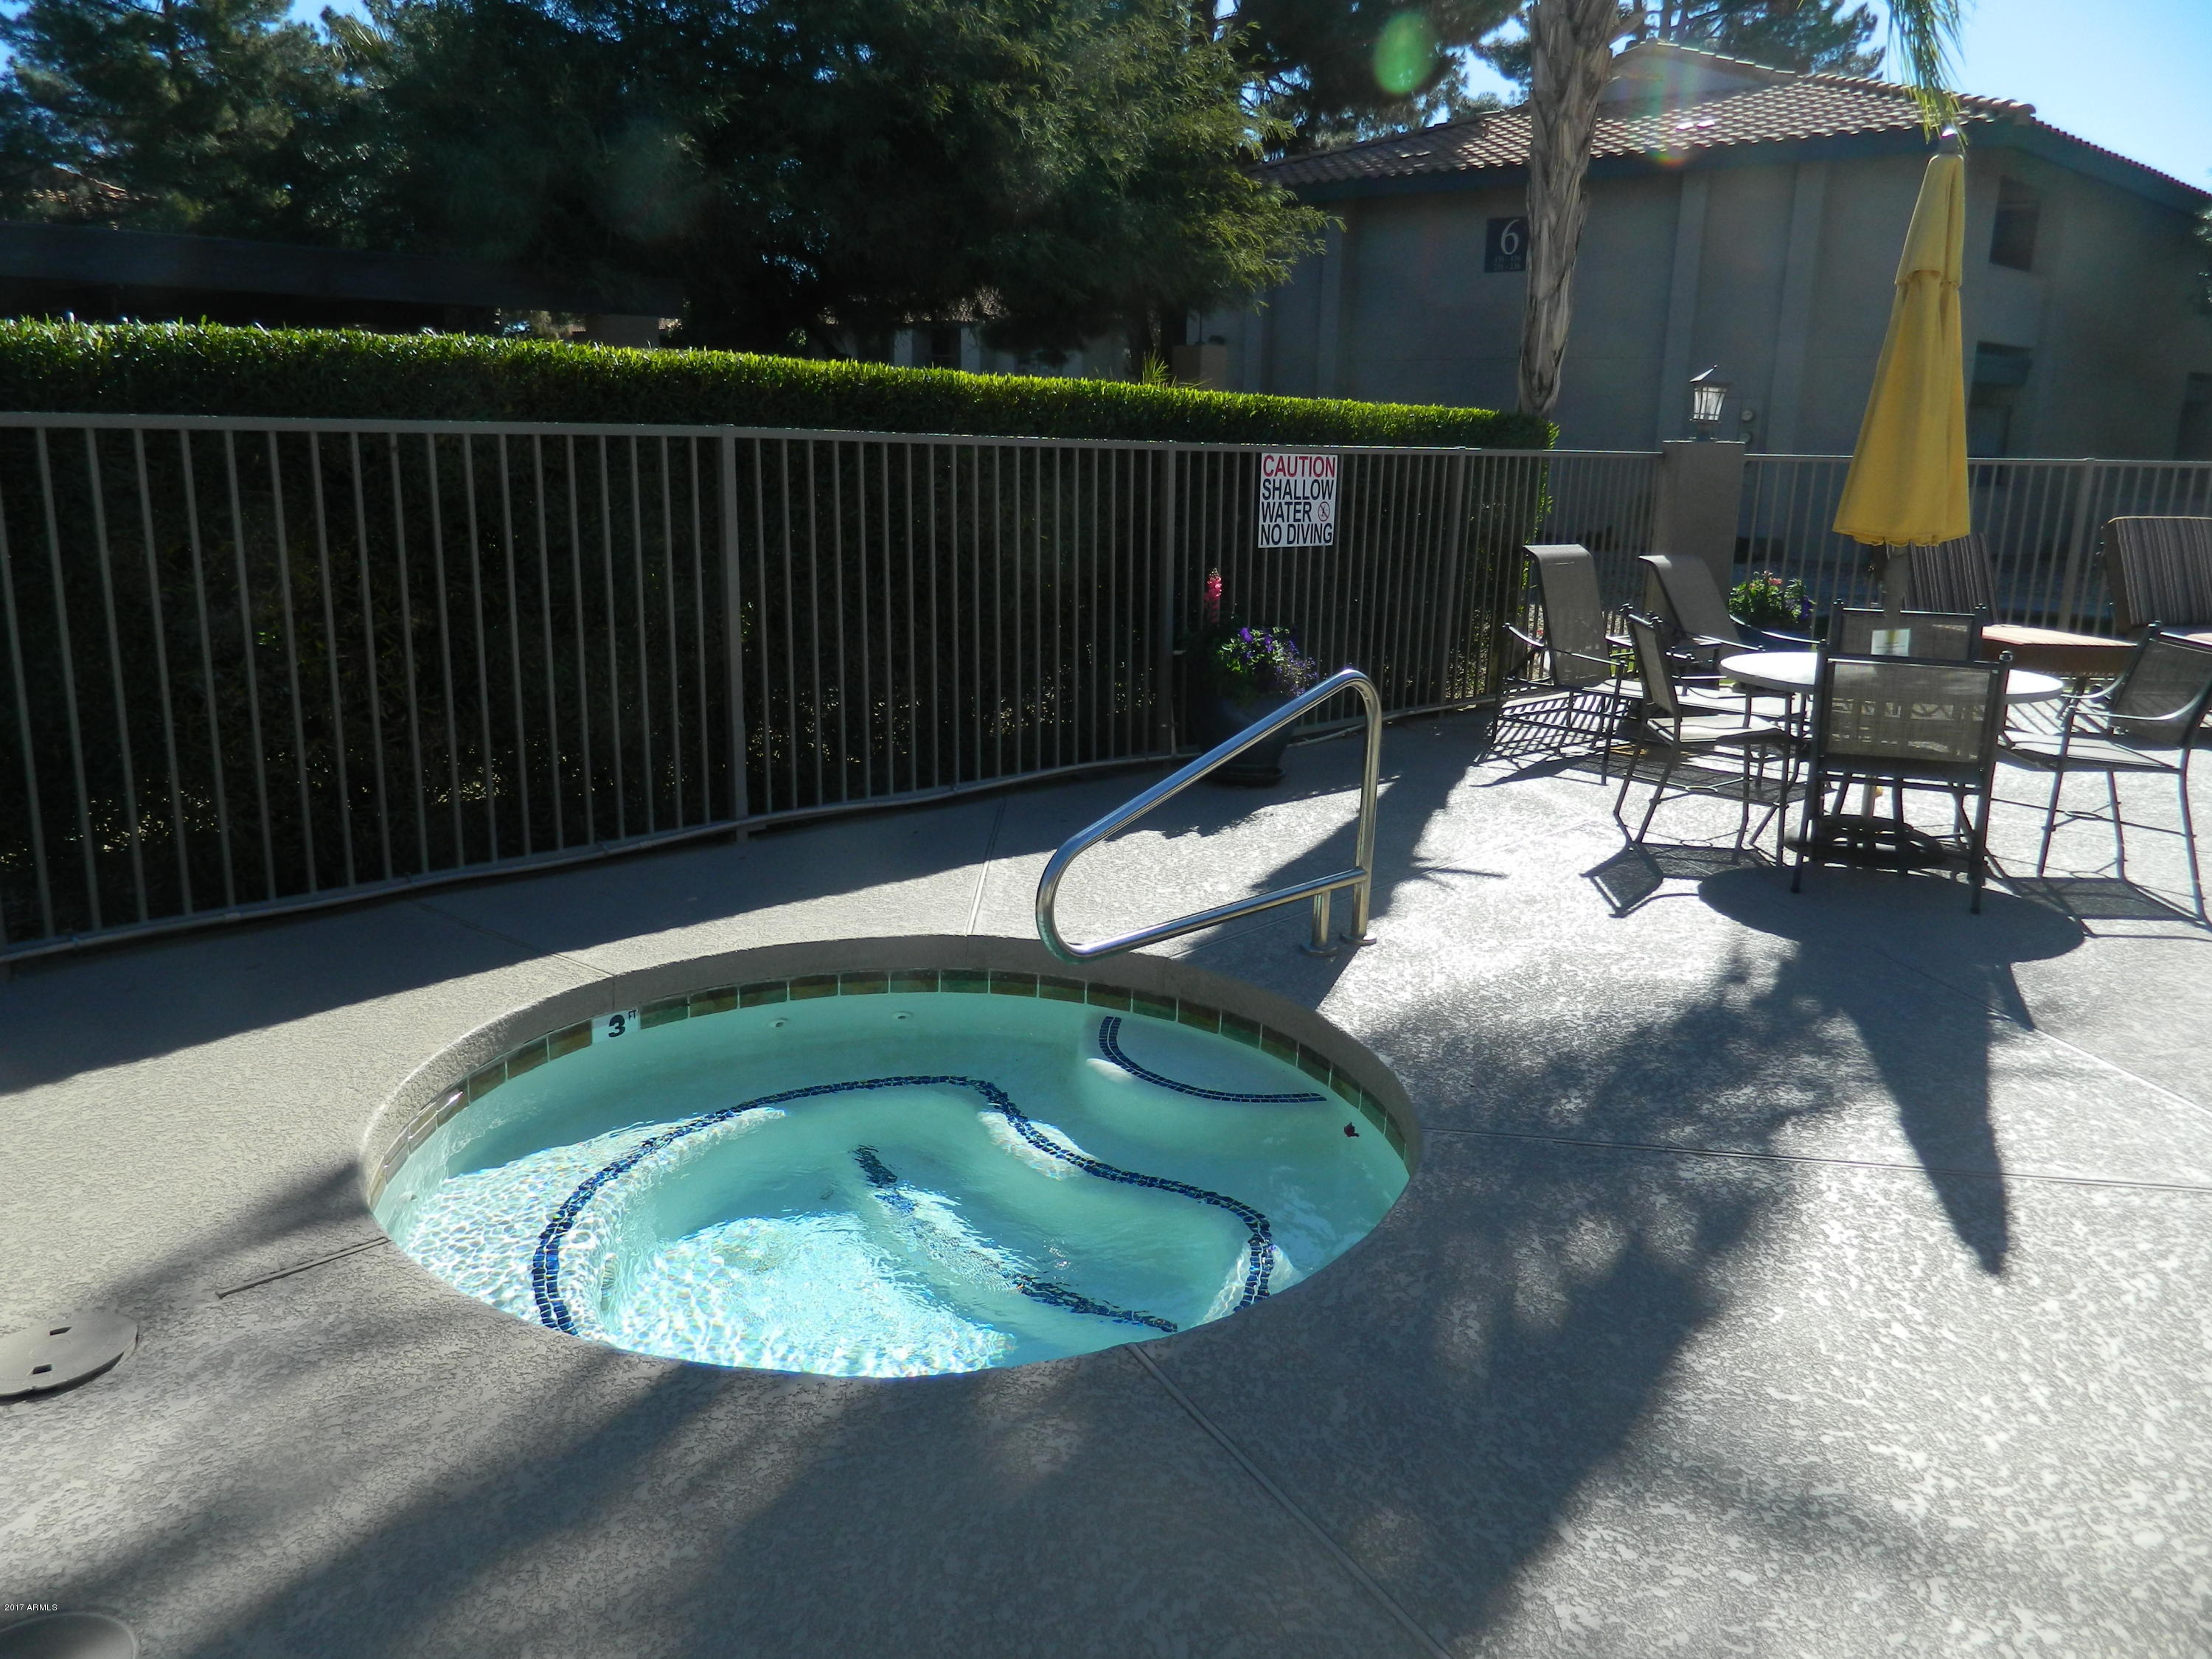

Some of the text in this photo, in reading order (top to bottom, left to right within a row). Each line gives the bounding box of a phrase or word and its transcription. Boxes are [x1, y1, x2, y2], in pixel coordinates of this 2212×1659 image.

[1500, 218, 1520, 254] 6
[1262, 455, 1336, 478] CAUTION
[1262, 478, 1335, 501] SHALLOW
[1261, 501, 1312, 523] WATER
[1260, 523, 1333, 545] NO DIVING
[608, 1009, 637, 1037] 3 FT
